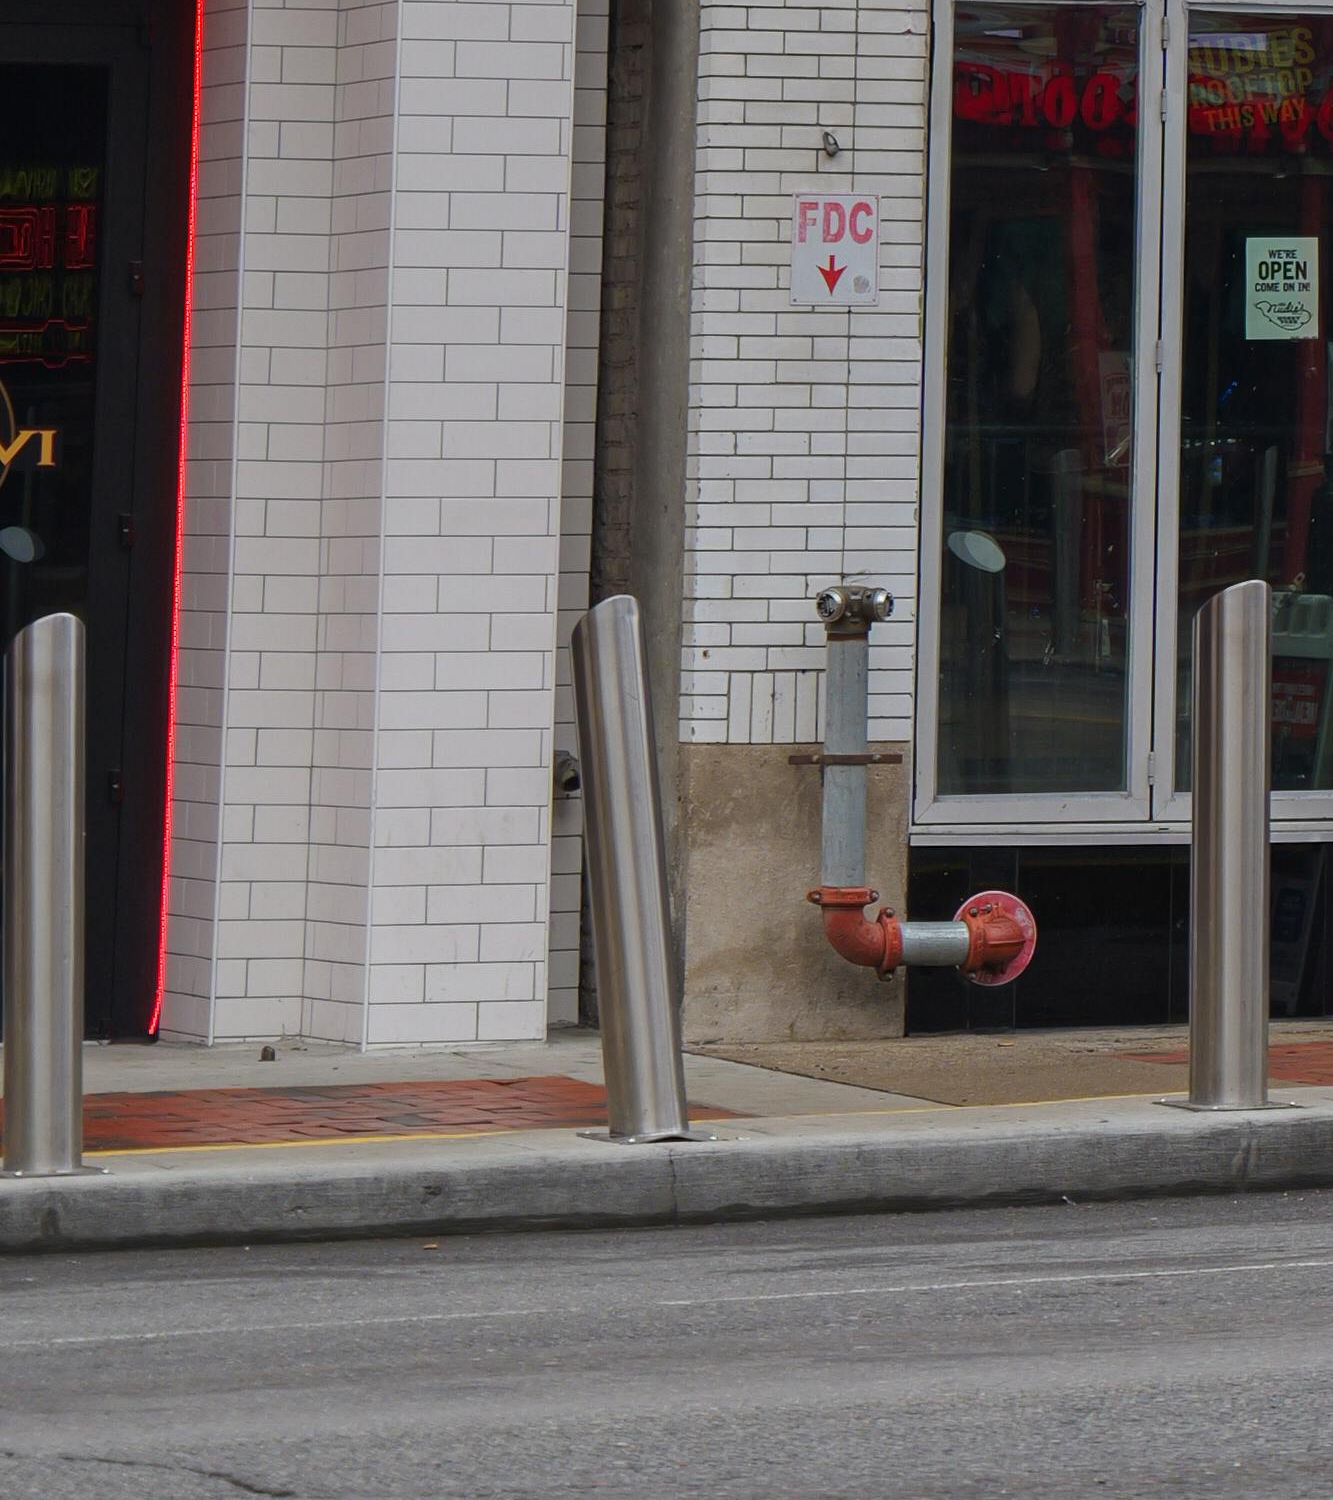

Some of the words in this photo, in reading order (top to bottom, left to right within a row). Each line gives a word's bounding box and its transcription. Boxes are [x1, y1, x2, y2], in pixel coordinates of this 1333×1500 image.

[1205, 100, 1255, 133] THIS
[1258, 96, 1307, 128] WAY
[798, 202, 874, 244] FDC
[1268, 249, 1298, 260] WE'RE
[1258, 261, 1308, 281] OPEN
[1254, 282, 1281, 293] COME
[1282, 282, 1295, 293] ON
